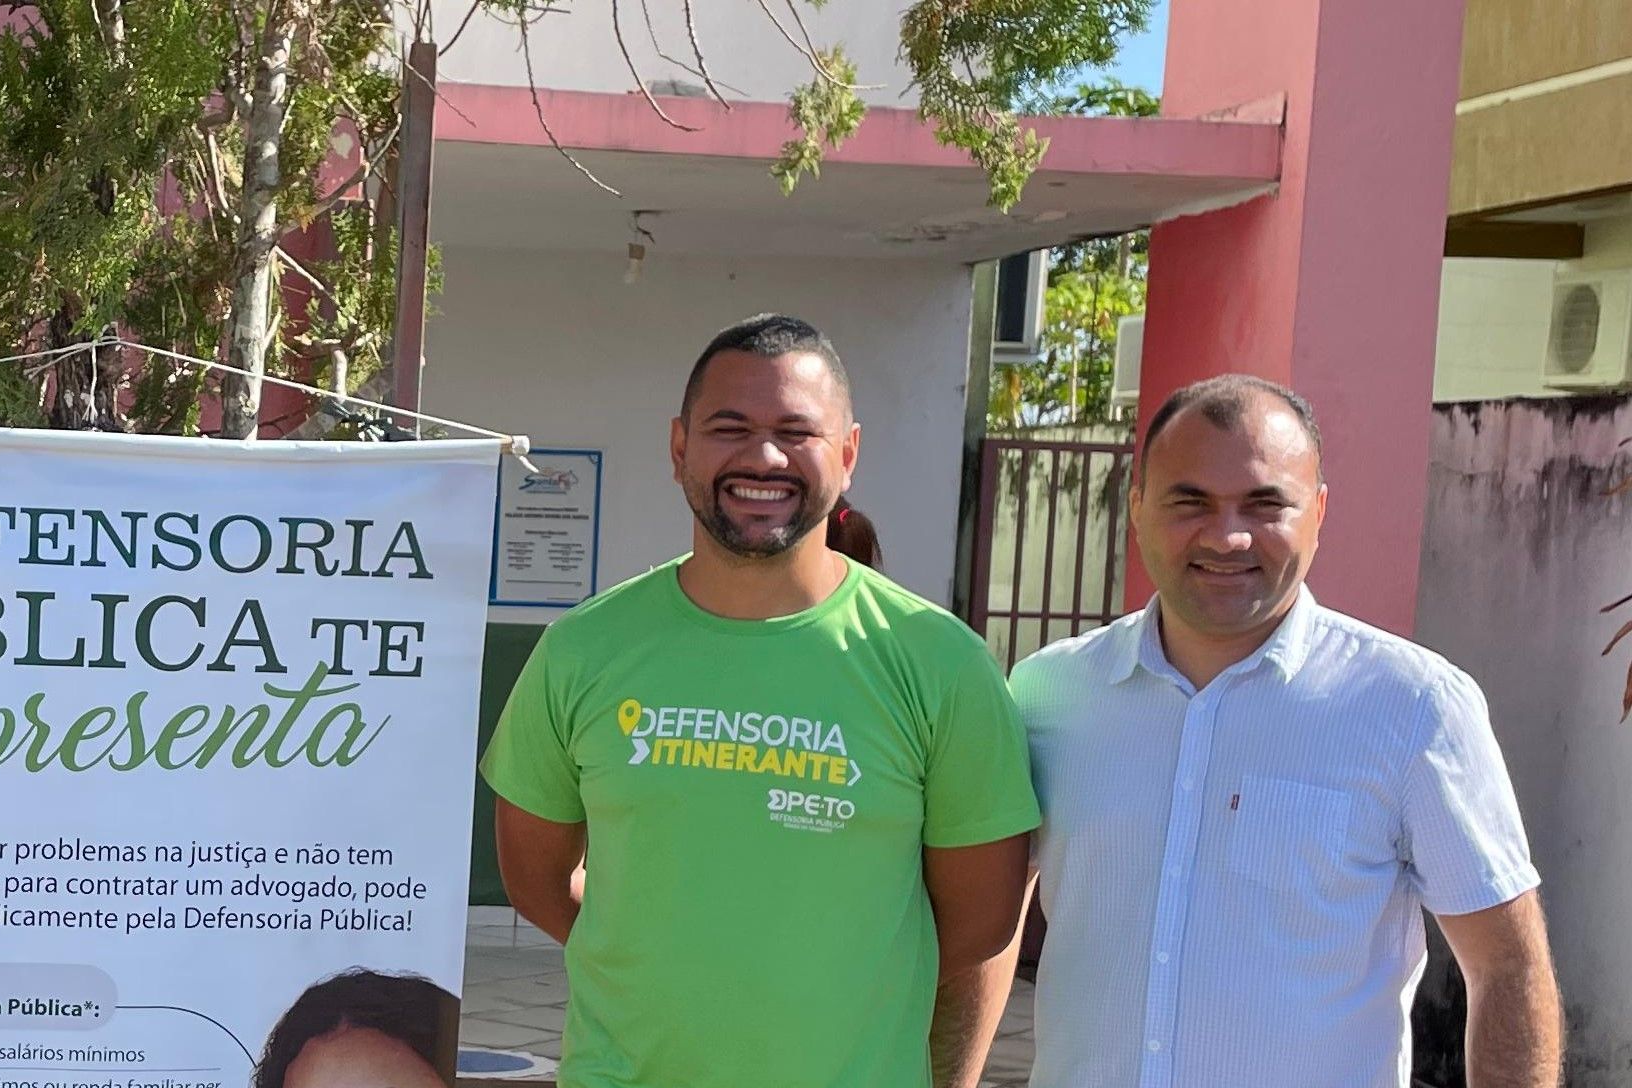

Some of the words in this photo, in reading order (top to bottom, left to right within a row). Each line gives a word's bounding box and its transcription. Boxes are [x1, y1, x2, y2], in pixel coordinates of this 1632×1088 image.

[310, 617, 426, 678] TE
[631, 706, 848, 757] DEFENSORIA
[651, 738, 848, 785] ITINERANTE
[16, 838, 147, 865] problemas
[154, 844, 183, 863] na
[188, 841, 267, 869] justiça
[274, 846, 289, 863] e
[296, 844, 340, 866] não
[347, 845, 393, 866] tem
[5, 873, 58, 899] para
[66, 874, 179, 896] contratar
[186, 877, 223, 896] um
[230, 874, 357, 903] advogado,
[365, 877, 427, 903] pode
[126, 906, 176, 935] pela
[184, 906, 312, 931] Defensoria
[320, 908, 413, 932] Pública!
[68, 1045, 145, 1063] mínimos
